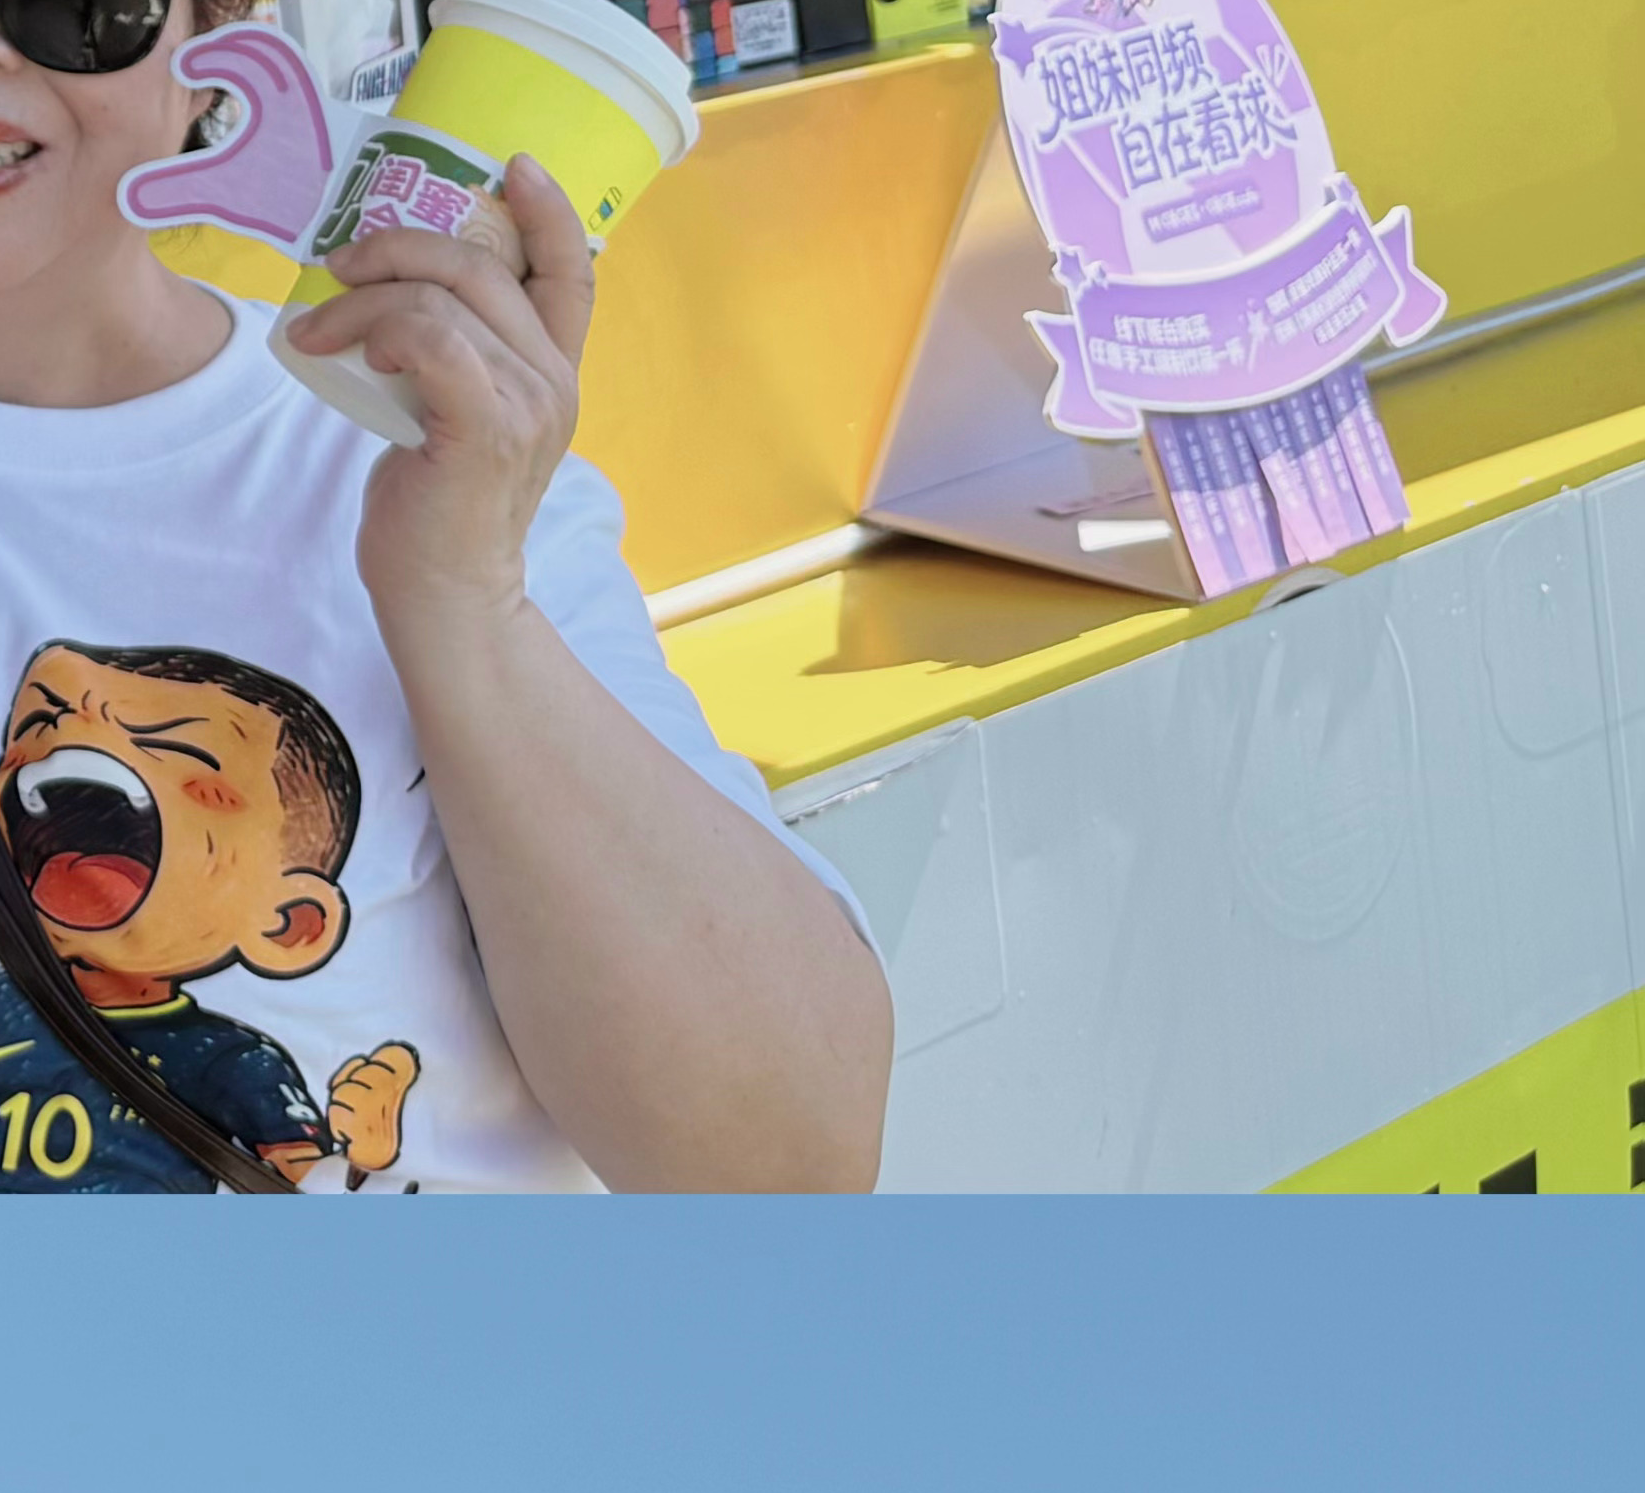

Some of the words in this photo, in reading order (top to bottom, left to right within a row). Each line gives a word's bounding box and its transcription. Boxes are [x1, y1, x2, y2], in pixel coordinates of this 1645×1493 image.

[356, 50, 418, 102] ENGLAN
[1038, 21, 1213, 144] 姐妹同频
[1117, 74, 1299, 190] 自在看球
[368, 158, 471, 232] 闺蜜
